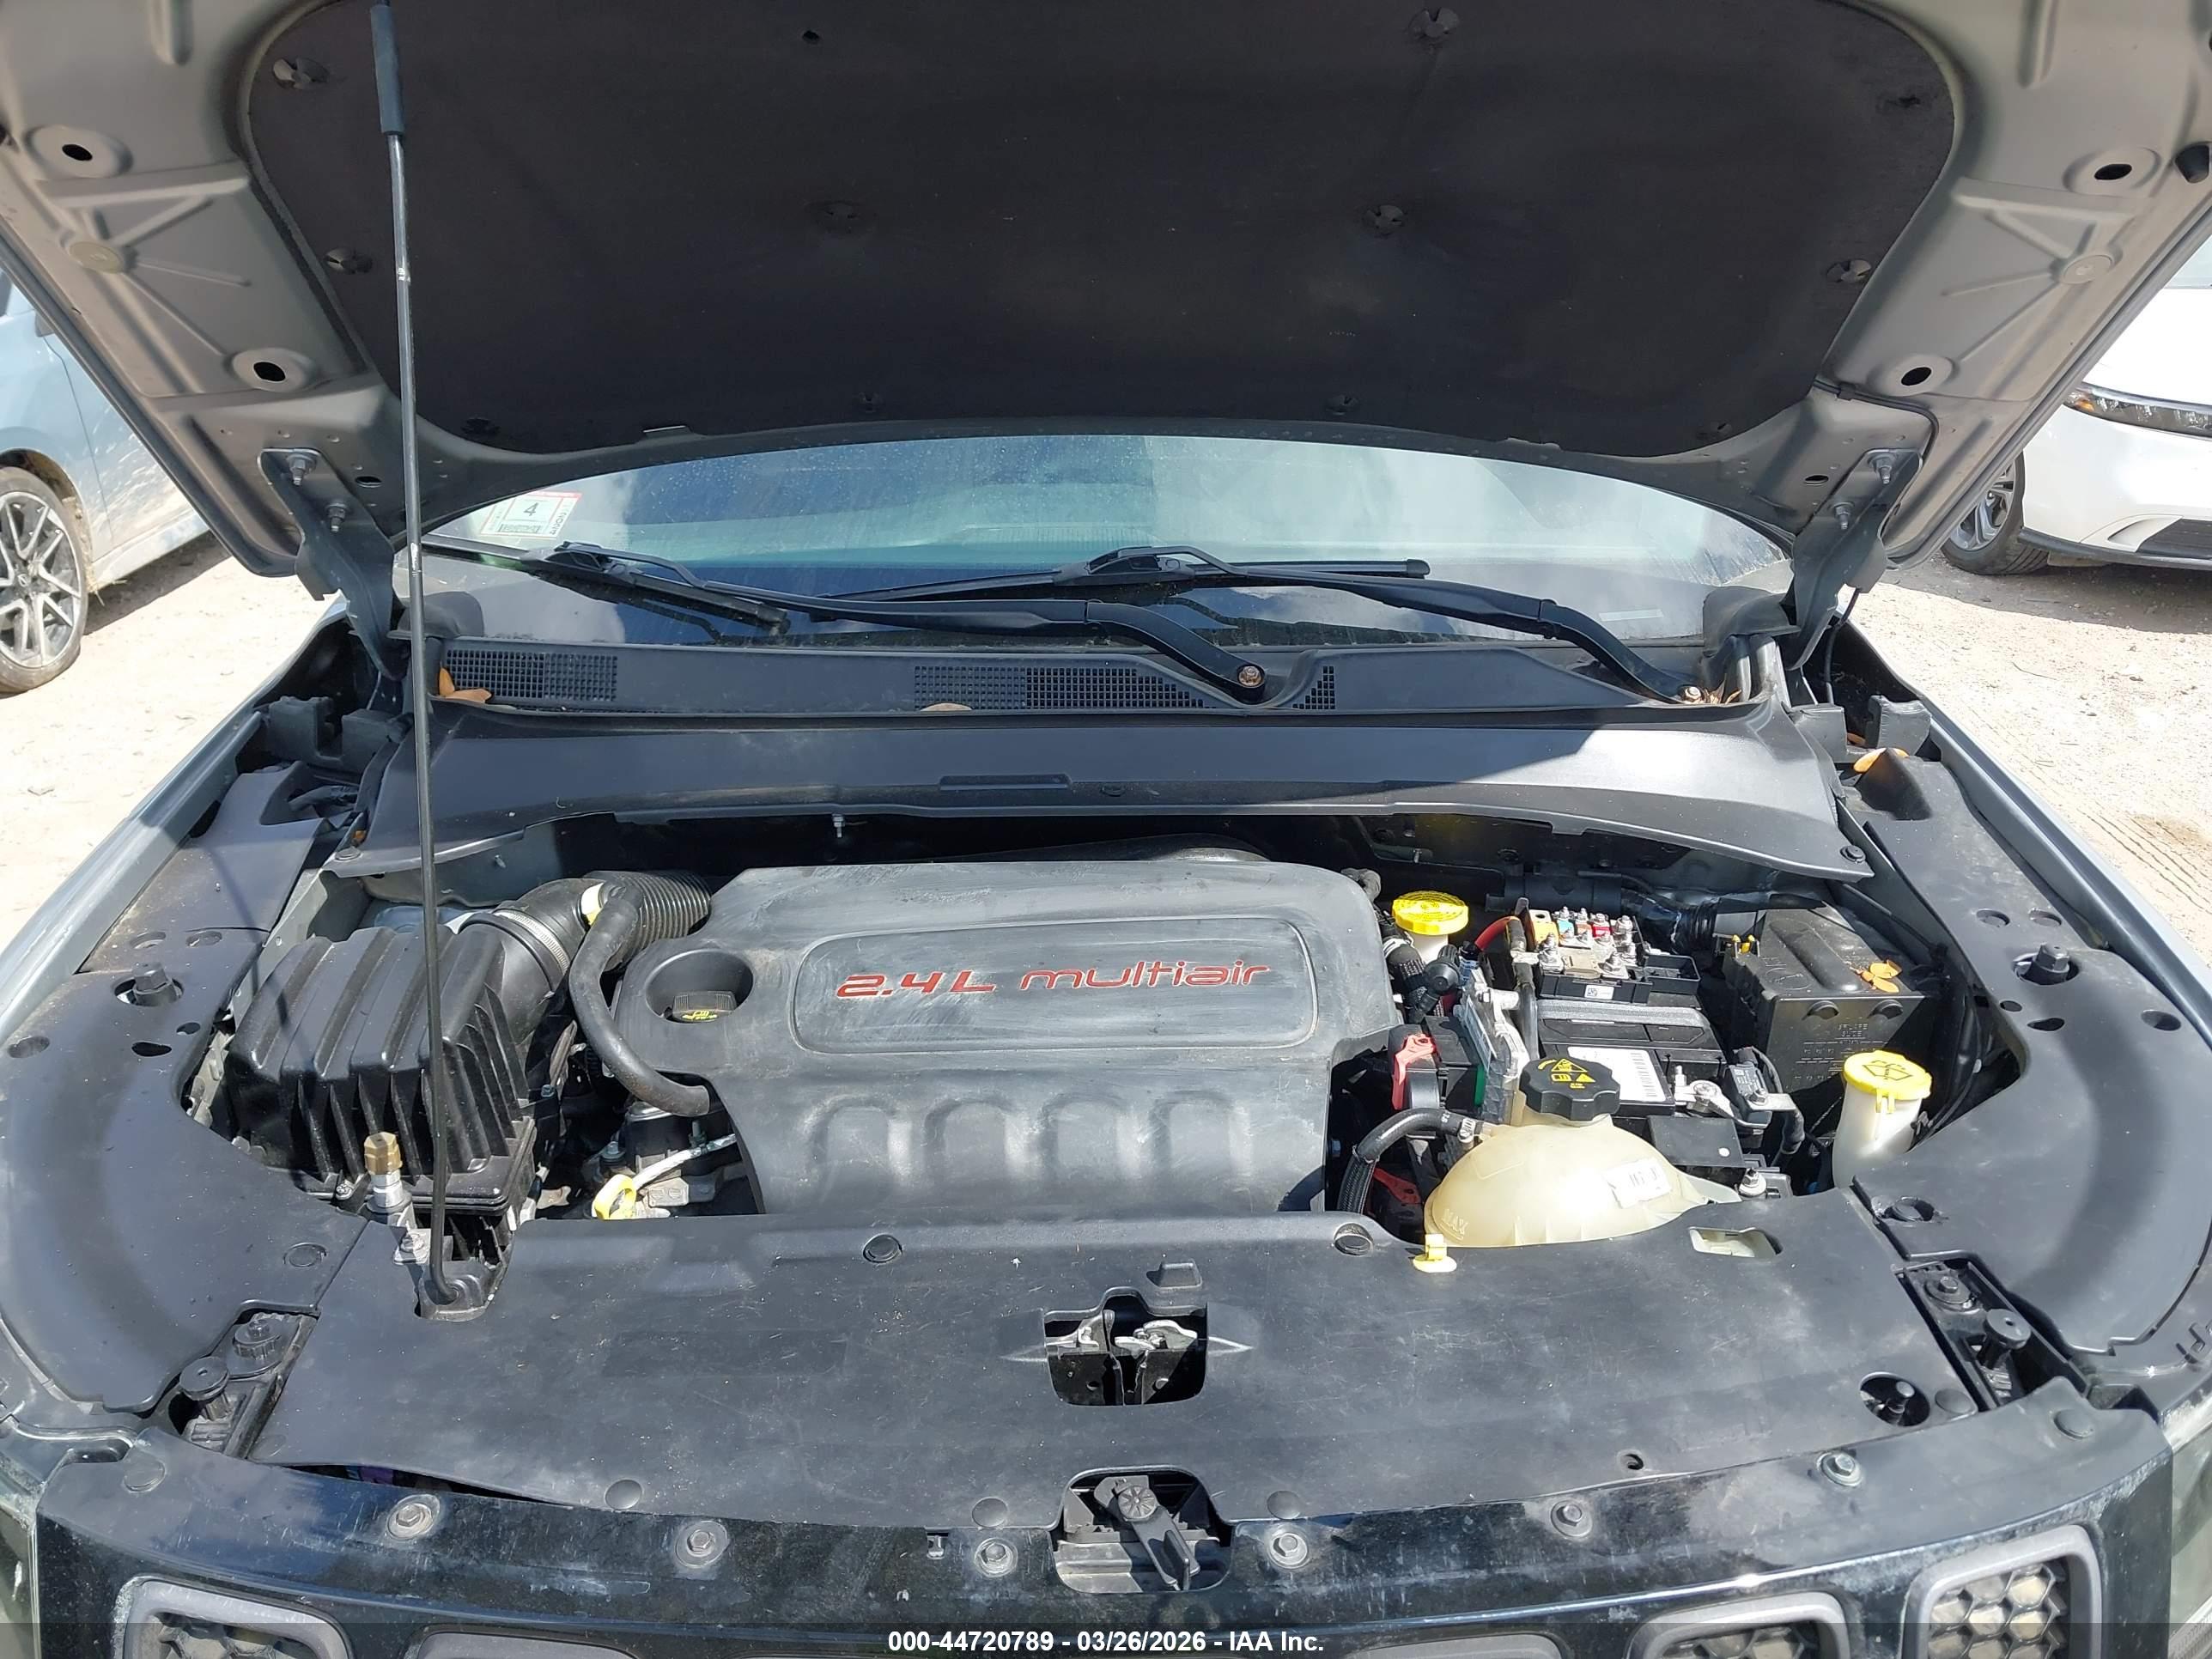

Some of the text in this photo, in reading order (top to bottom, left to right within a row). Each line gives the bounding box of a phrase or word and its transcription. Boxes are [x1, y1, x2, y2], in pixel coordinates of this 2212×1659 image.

[523, 502, 539, 517] 4
[836, 959, 1271, 999] 2.4L multiair
